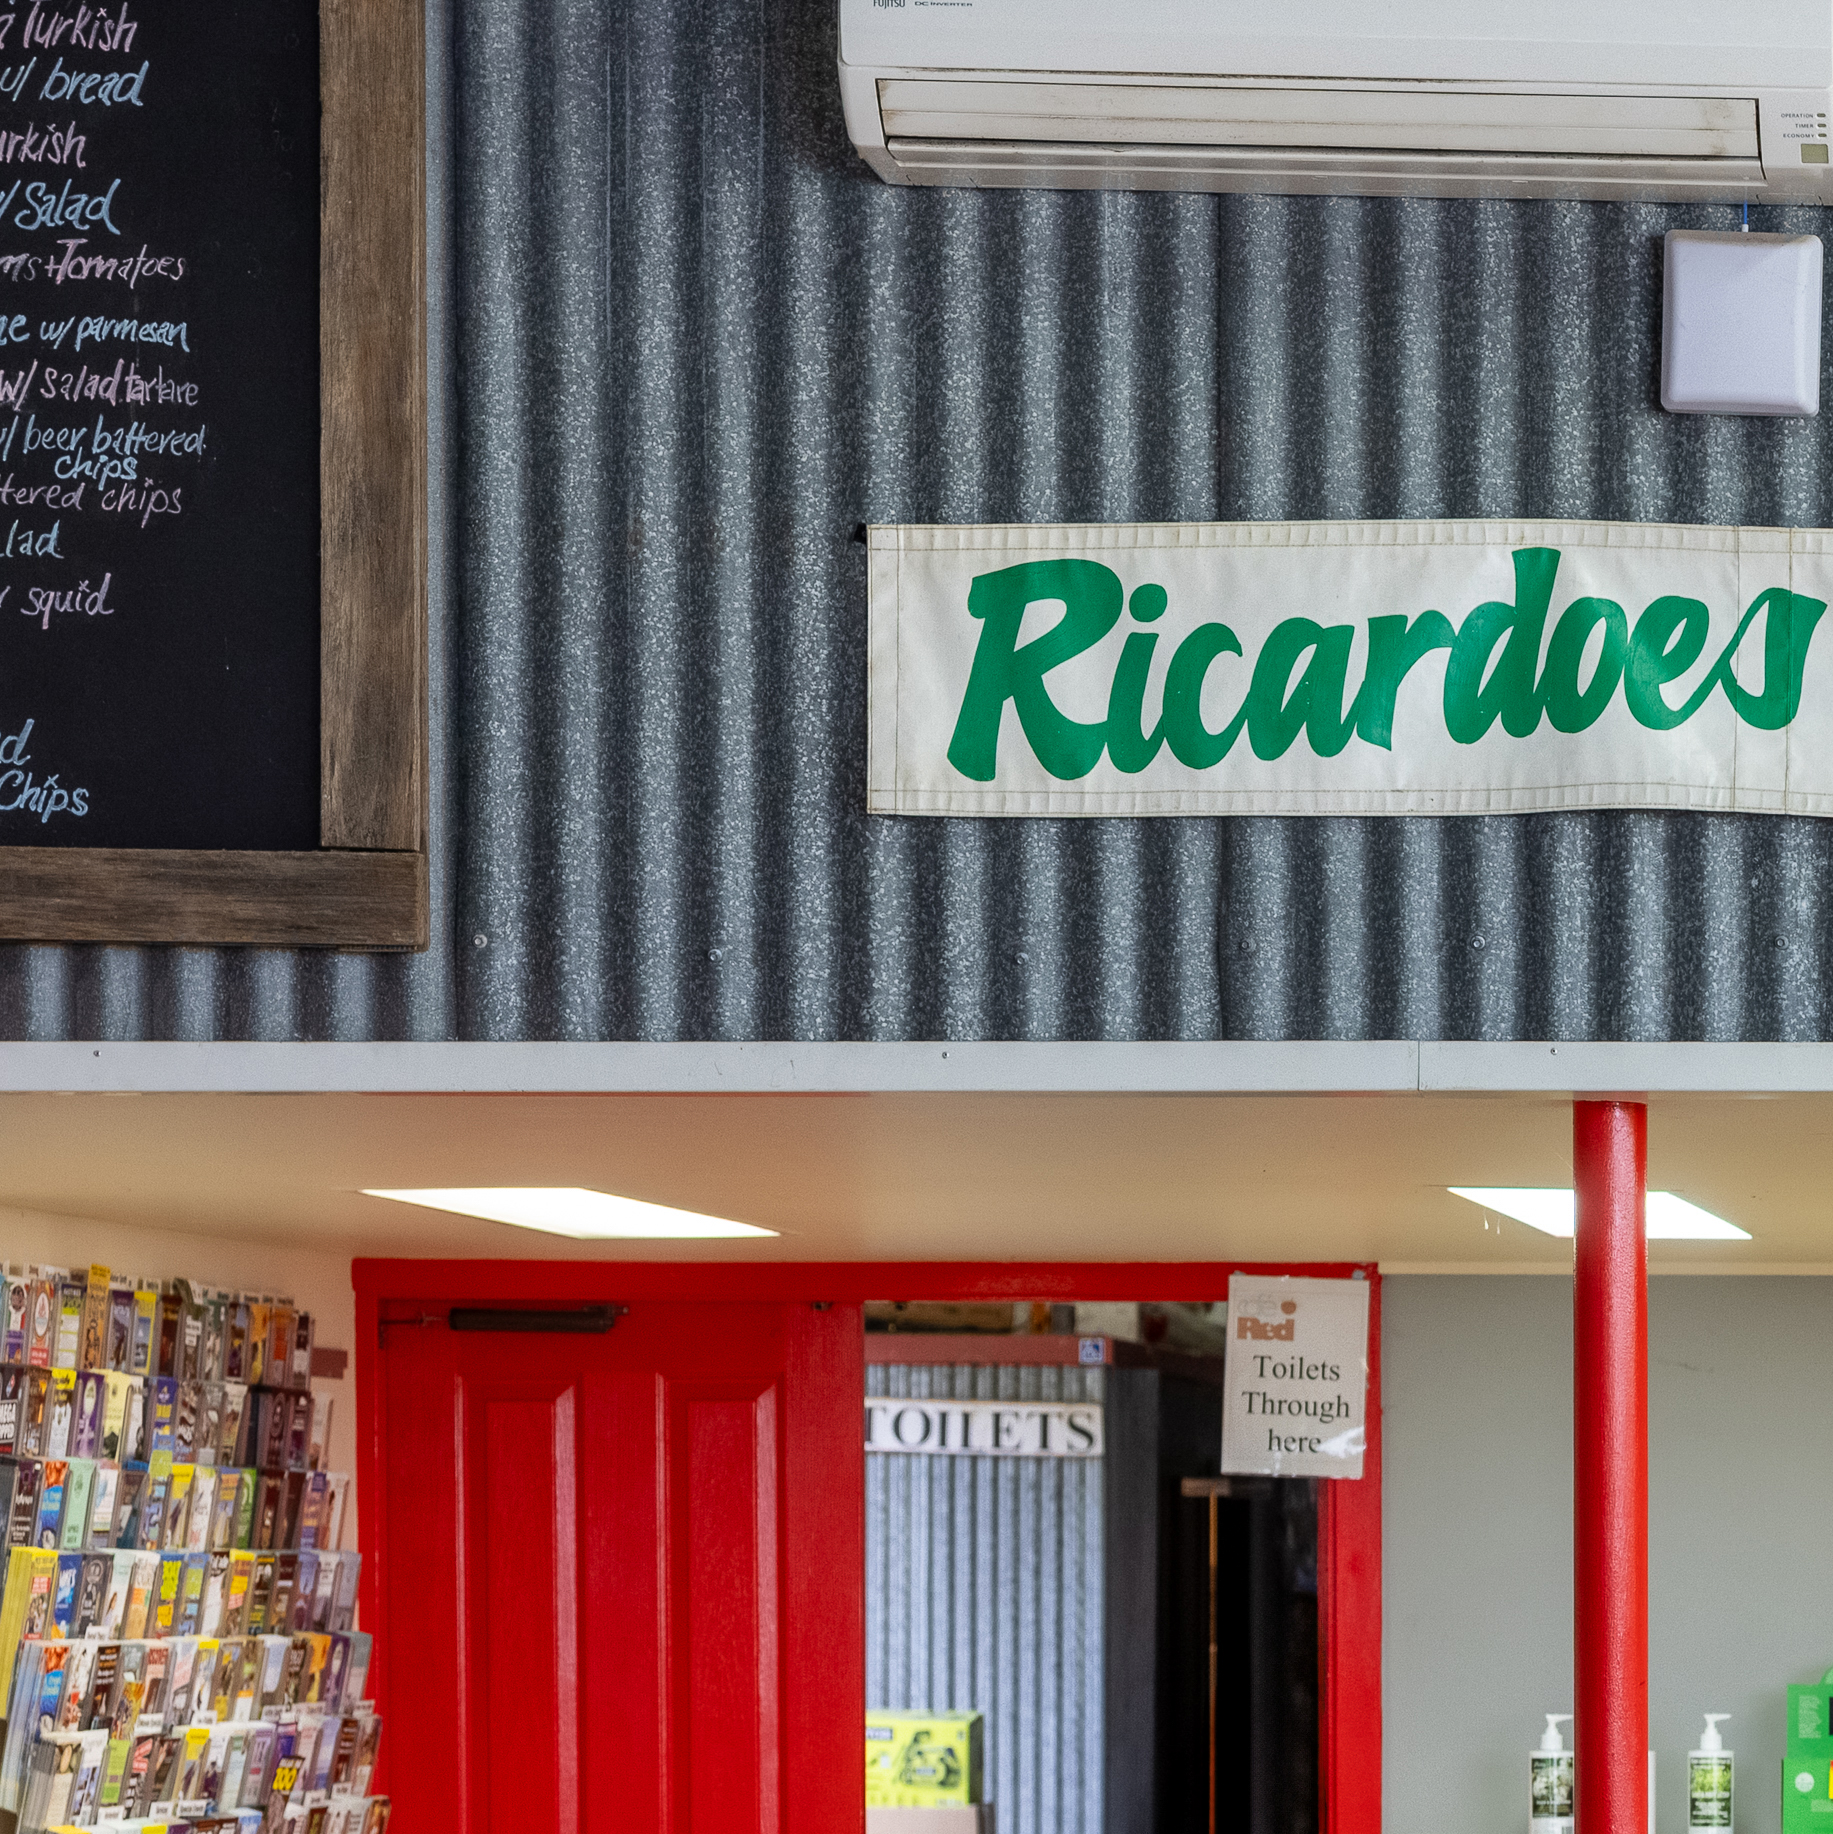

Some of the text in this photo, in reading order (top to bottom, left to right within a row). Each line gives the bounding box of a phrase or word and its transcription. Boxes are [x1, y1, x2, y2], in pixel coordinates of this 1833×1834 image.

[39, 57, 149, 106] bread
[14, 178, 121, 235] Salad
[75, 316, 190, 352] parmesan
[125, 362, 199, 405] tartare
[24, 414, 87, 454] beer
[101, 477, 182, 528] chips
[20, 572, 114, 630] squid
[947, 546, 1828, 782] Ricardoes
[1236, 1316, 1296, 1342] Red
[1252, 1354, 1341, 1382] Toilets
[1241, 1391, 1351, 1424] Through
[1266, 1427, 1322, 1455] here
